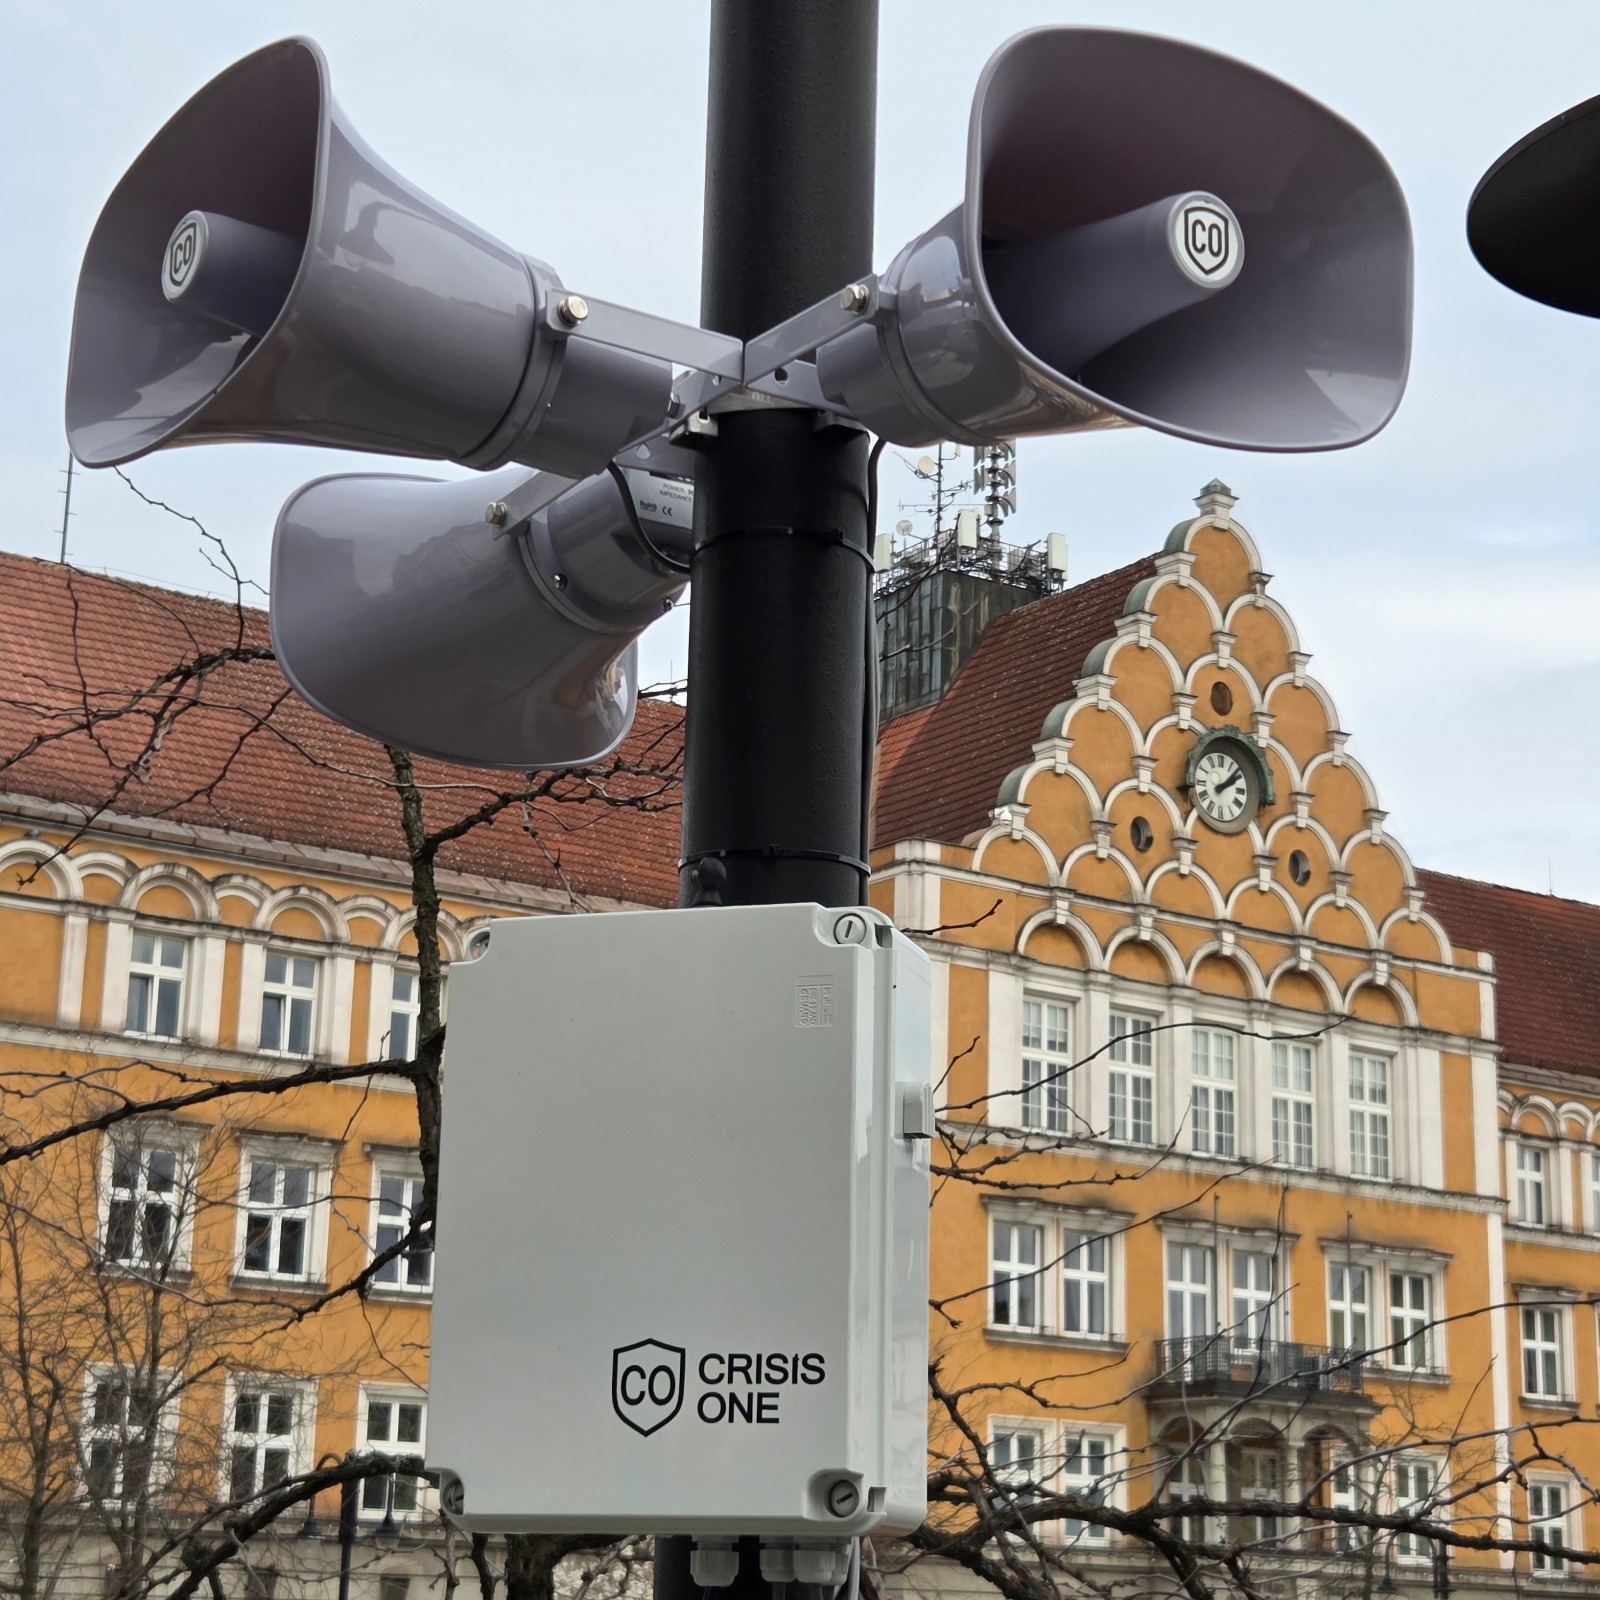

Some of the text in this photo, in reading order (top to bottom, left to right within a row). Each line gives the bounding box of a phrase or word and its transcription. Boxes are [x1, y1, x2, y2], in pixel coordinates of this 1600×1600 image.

[173, 234, 193, 275] CO
[1191, 219, 1222, 258] CO
[621, 1364, 676, 1406] CO
[698, 1353, 826, 1385] CRISIS
[697, 1391, 780, 1424] ONE
